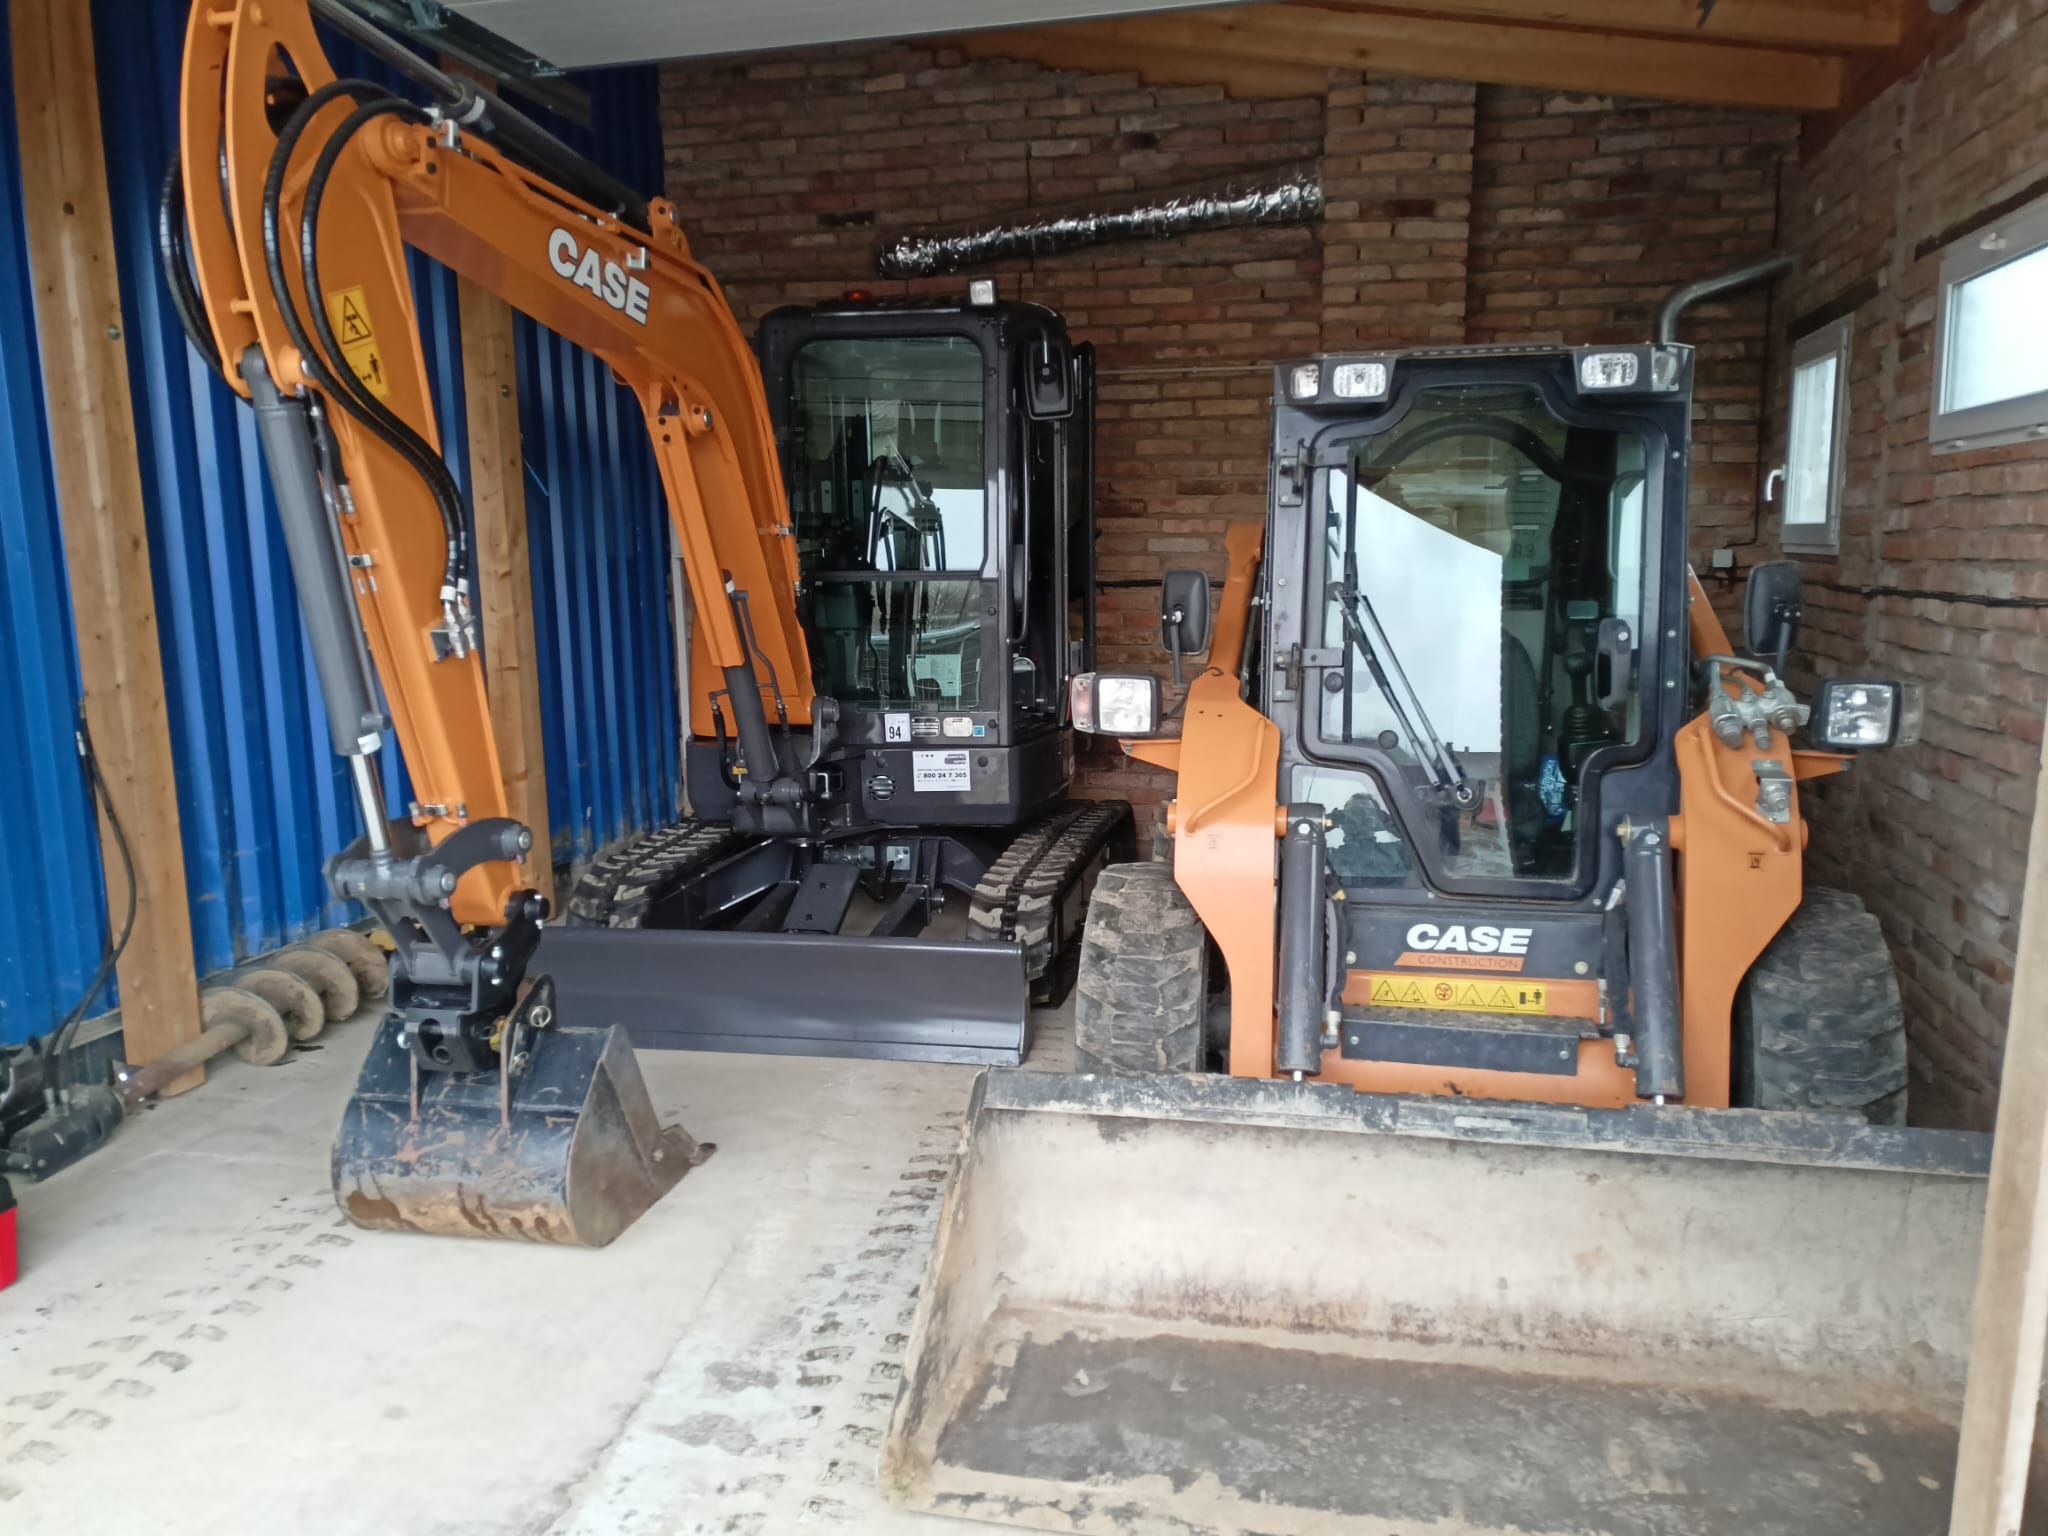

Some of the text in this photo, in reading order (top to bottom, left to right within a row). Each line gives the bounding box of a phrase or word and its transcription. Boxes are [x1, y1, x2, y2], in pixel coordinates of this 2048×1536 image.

[548, 228, 650, 325] CASE
[889, 726, 901, 739] 94
[1406, 923, 1533, 954] CASE
[1417, 955, 1518, 969] CONSTRUCTION
